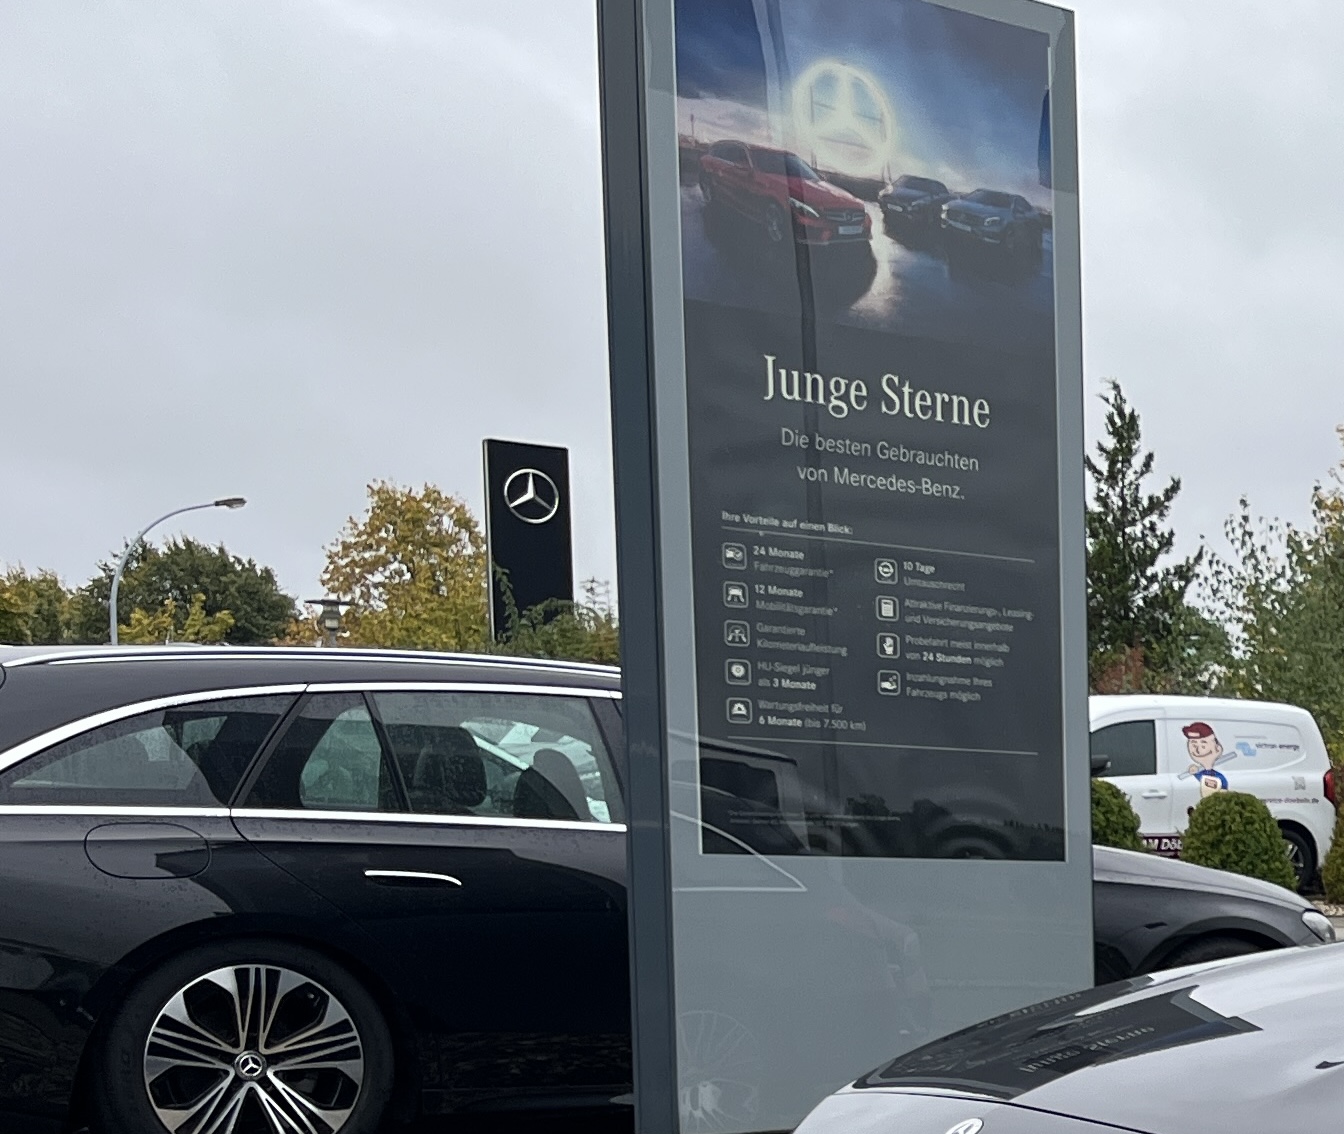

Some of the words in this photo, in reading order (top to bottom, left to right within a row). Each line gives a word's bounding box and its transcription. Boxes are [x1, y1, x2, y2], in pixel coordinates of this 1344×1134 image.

[763, 354, 868, 418] Junge
[881, 373, 990, 428] Sterne
[781, 427, 809, 449] Die
[815, 432, 871, 457] besten
[877, 441, 979, 471] Gebrauchten
[797, 465, 828, 482] von
[834, 466, 965, 500] Mercedes-Benz.
[721, 510, 741, 523] Ihre
[742, 513, 780, 527] Vorteile
[781, 519, 798, 529] auf
[800, 521, 825, 532] einen
[753, 545, 766, 556] 24
[768, 547, 805, 560] Monate
[903, 561, 914, 571] 10
[915, 562, 936, 575] Tage
[755, 584, 766, 595] 12
[768, 585, 804, 598] Monate
[922, 651, 934, 662] 24
[935, 652, 972, 665] Stunden
[772, 678, 779, 688] 3
[781, 678, 817, 691] Monate
[758, 716, 766, 725] 6
[768, 716, 803, 728] Monate
[823, 718, 848, 729] 7.500
